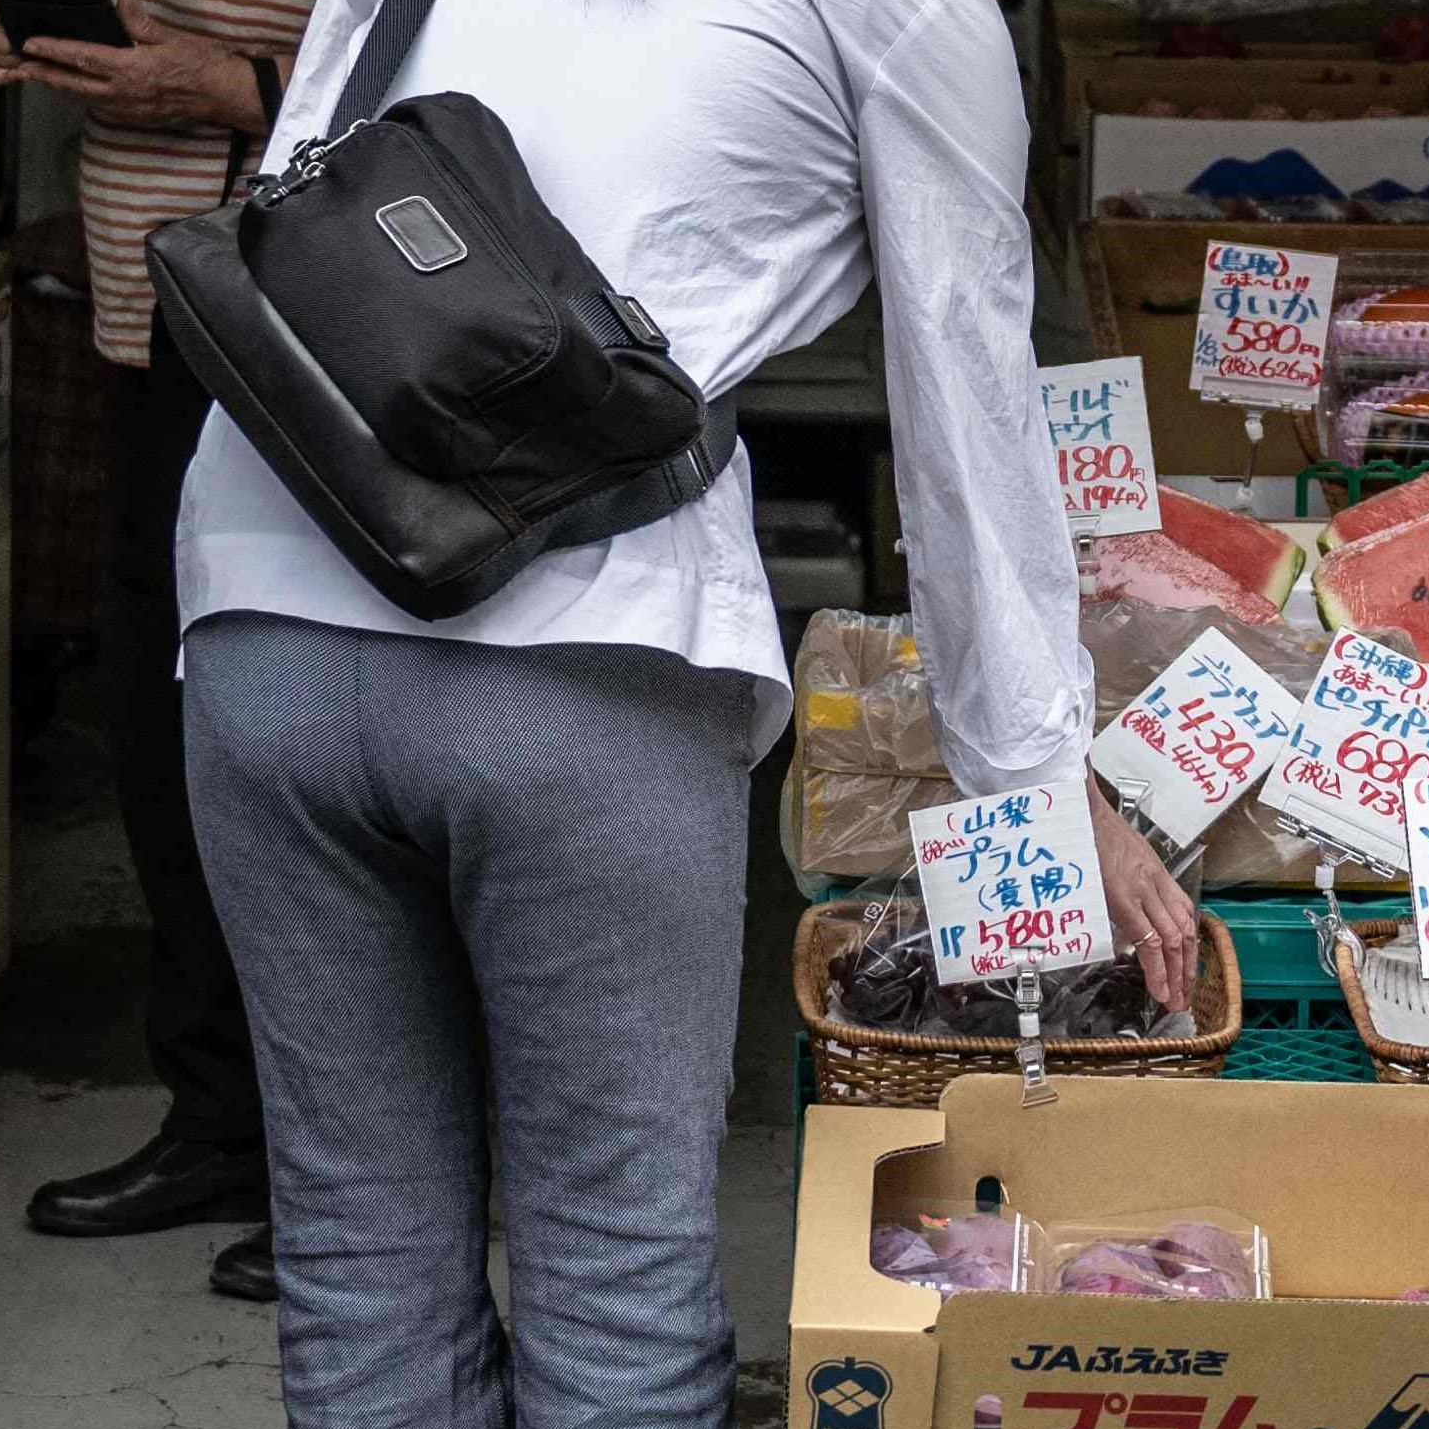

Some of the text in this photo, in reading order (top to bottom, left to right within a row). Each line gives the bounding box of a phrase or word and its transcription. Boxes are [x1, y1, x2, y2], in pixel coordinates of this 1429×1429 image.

[1208, 247, 1289, 277] (鳥取)
[1212, 285, 1320, 323] すいか
[1222, 317, 1320, 358] 580円
[1334, 633, 1427, 690] (沖縄)
[1187, 654, 1289, 739] デラウェア
[947, 788, 1053, 834] (山梨)
[945, 835, 1055, 883] プラム
[978, 862, 1083, 912] (貴陽)
[1011, 1344, 1230, 1377] JAふえふき
